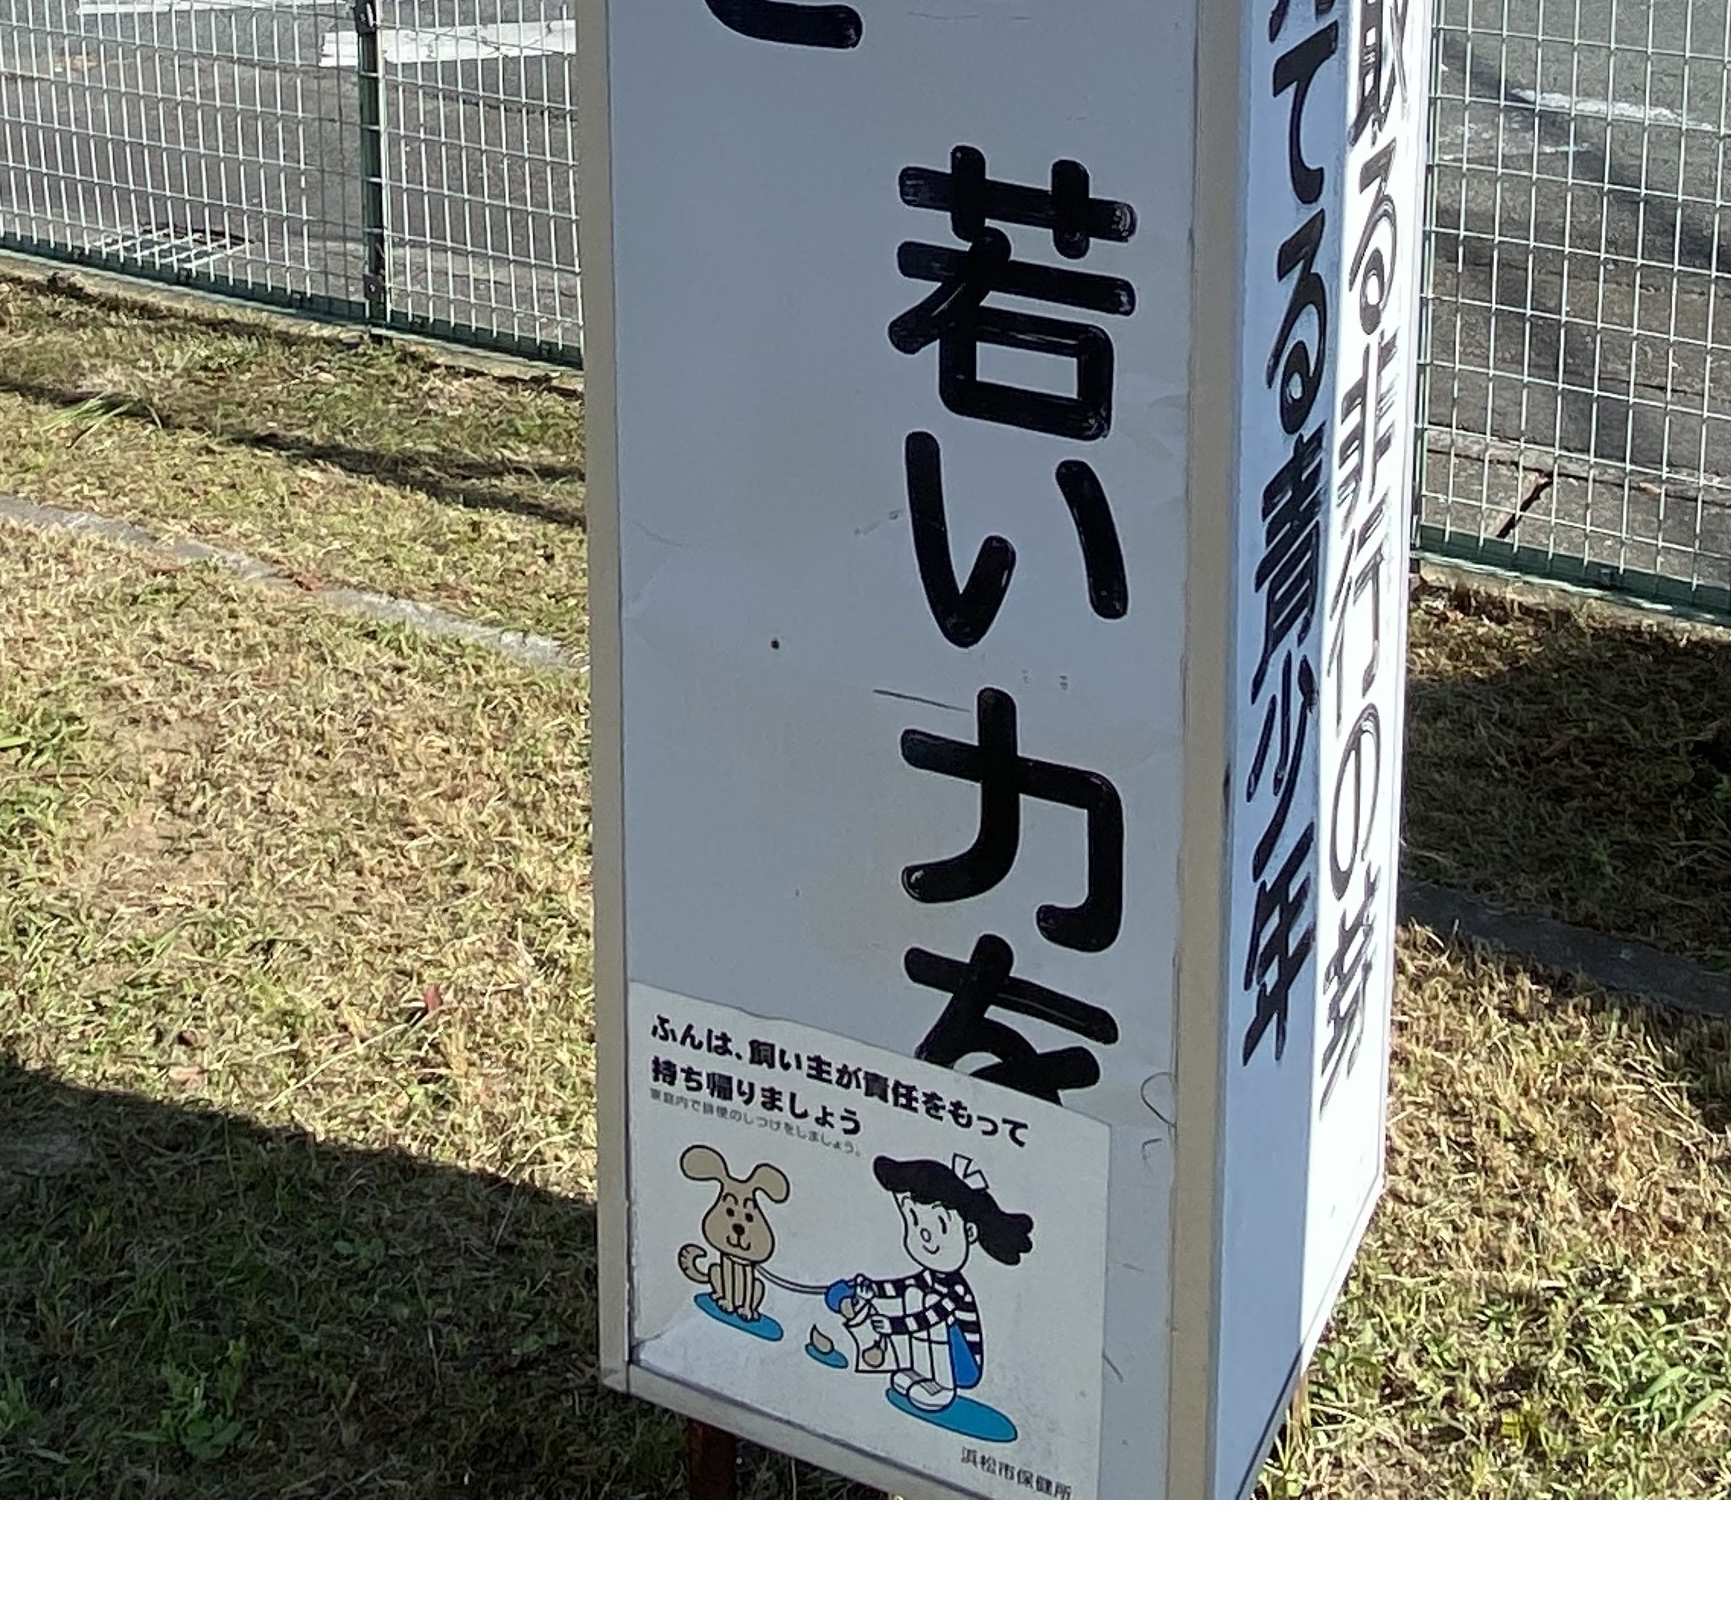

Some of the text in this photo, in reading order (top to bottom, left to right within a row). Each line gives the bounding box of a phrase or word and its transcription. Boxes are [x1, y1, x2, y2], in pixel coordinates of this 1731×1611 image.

[651, 1014, 1029, 1148] ふんは、飼い主が責任をもって
[652, 1055, 862, 1136] 持ち帰りましょう
